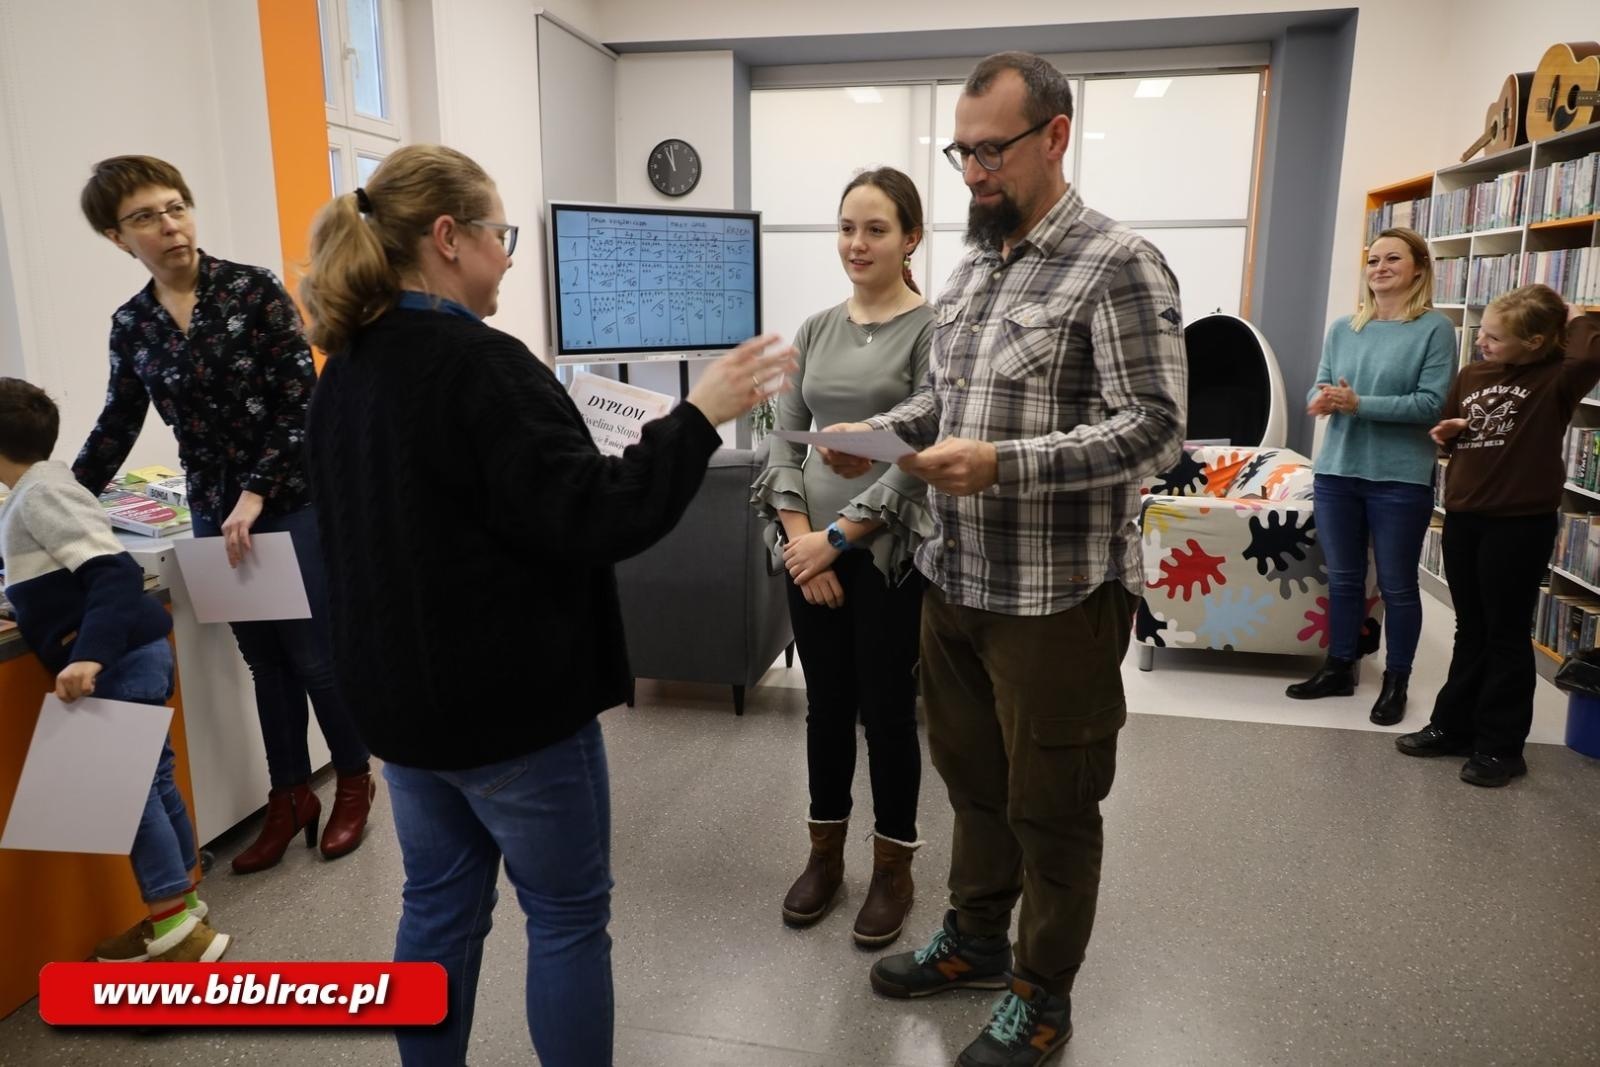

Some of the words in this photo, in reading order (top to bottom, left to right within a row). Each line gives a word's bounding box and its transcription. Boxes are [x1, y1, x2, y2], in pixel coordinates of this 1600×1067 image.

[569, 240, 577, 257] 1
[571, 265, 580, 288] 2
[727, 267, 743, 280] 56
[572, 297, 583, 317] 3
[727, 295, 744, 310] 57
[1462, 391, 1480, 407] YOU
[587, 395, 647, 420] DYPLOM
[1484, 439, 1505, 447] NEED
